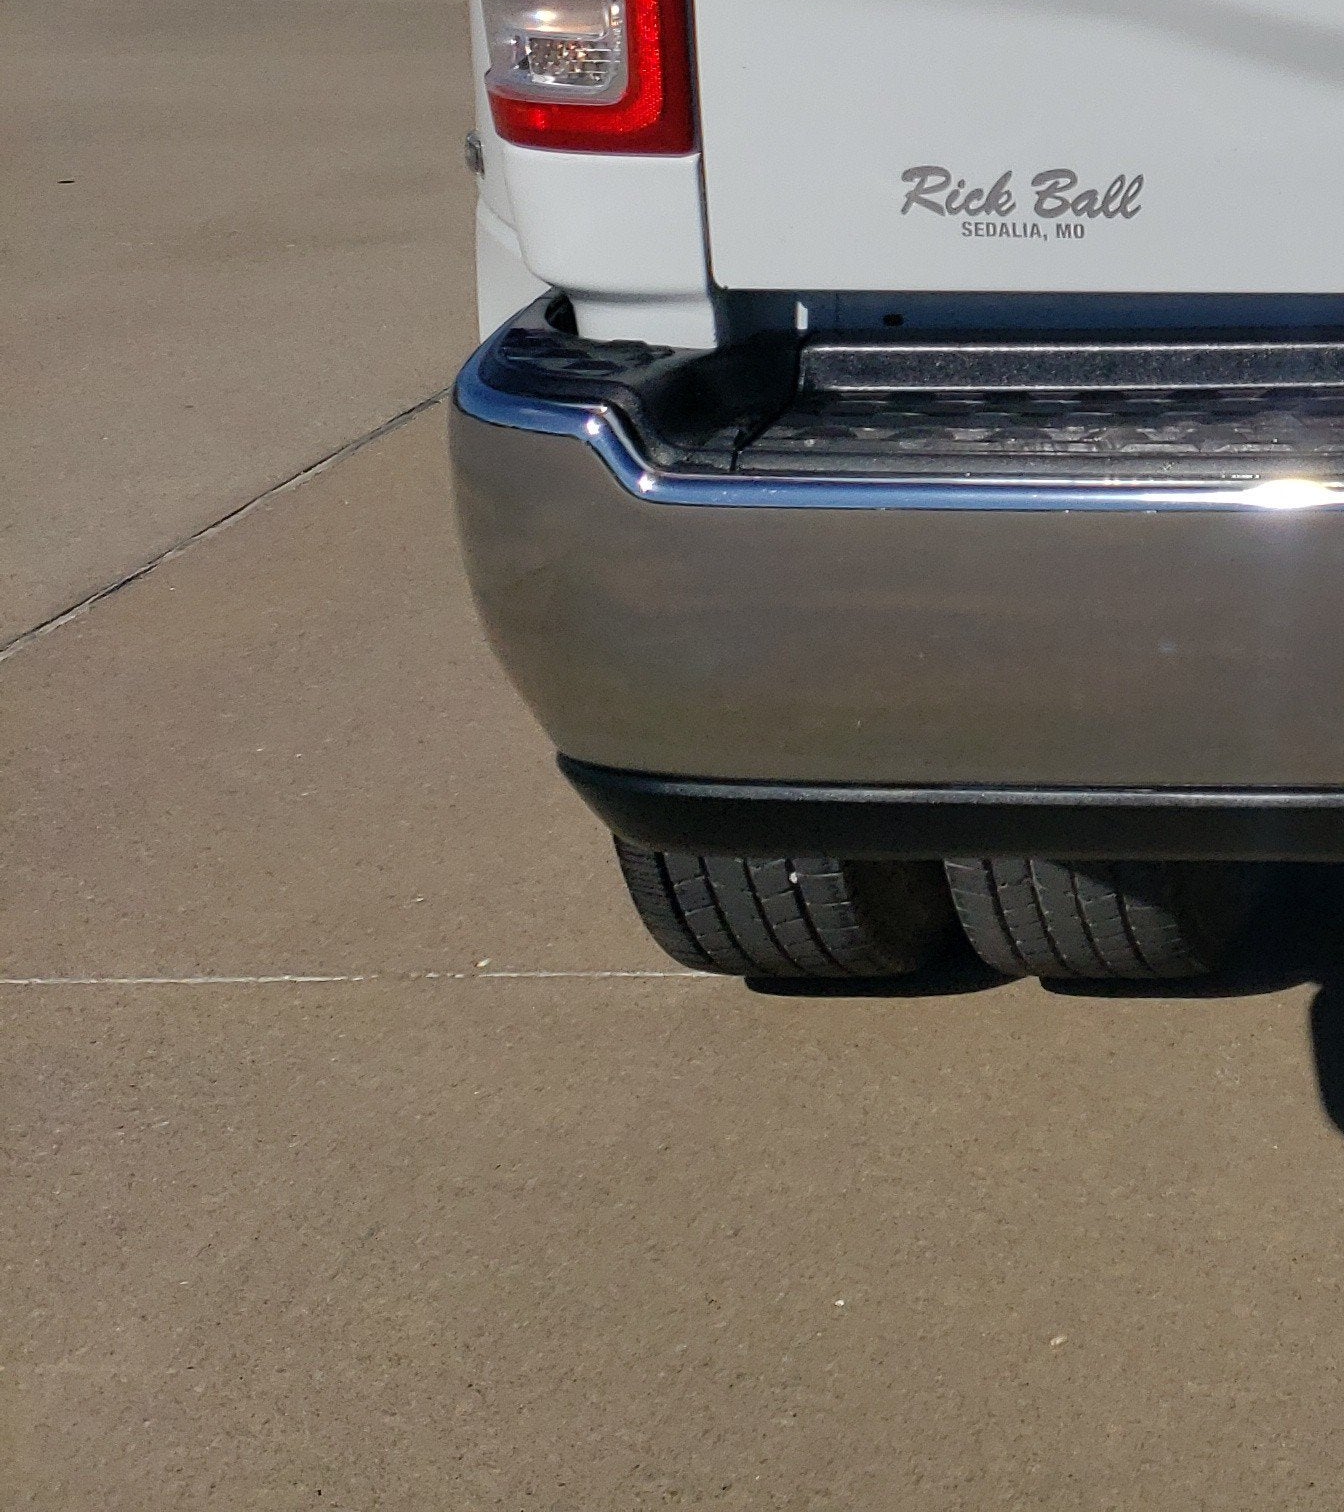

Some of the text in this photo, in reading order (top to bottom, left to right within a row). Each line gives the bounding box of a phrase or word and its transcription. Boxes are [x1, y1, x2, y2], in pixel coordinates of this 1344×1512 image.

[901, 165, 1144, 219] Rick Ball
[961, 221, 1085, 241] SEDALIA, MO
